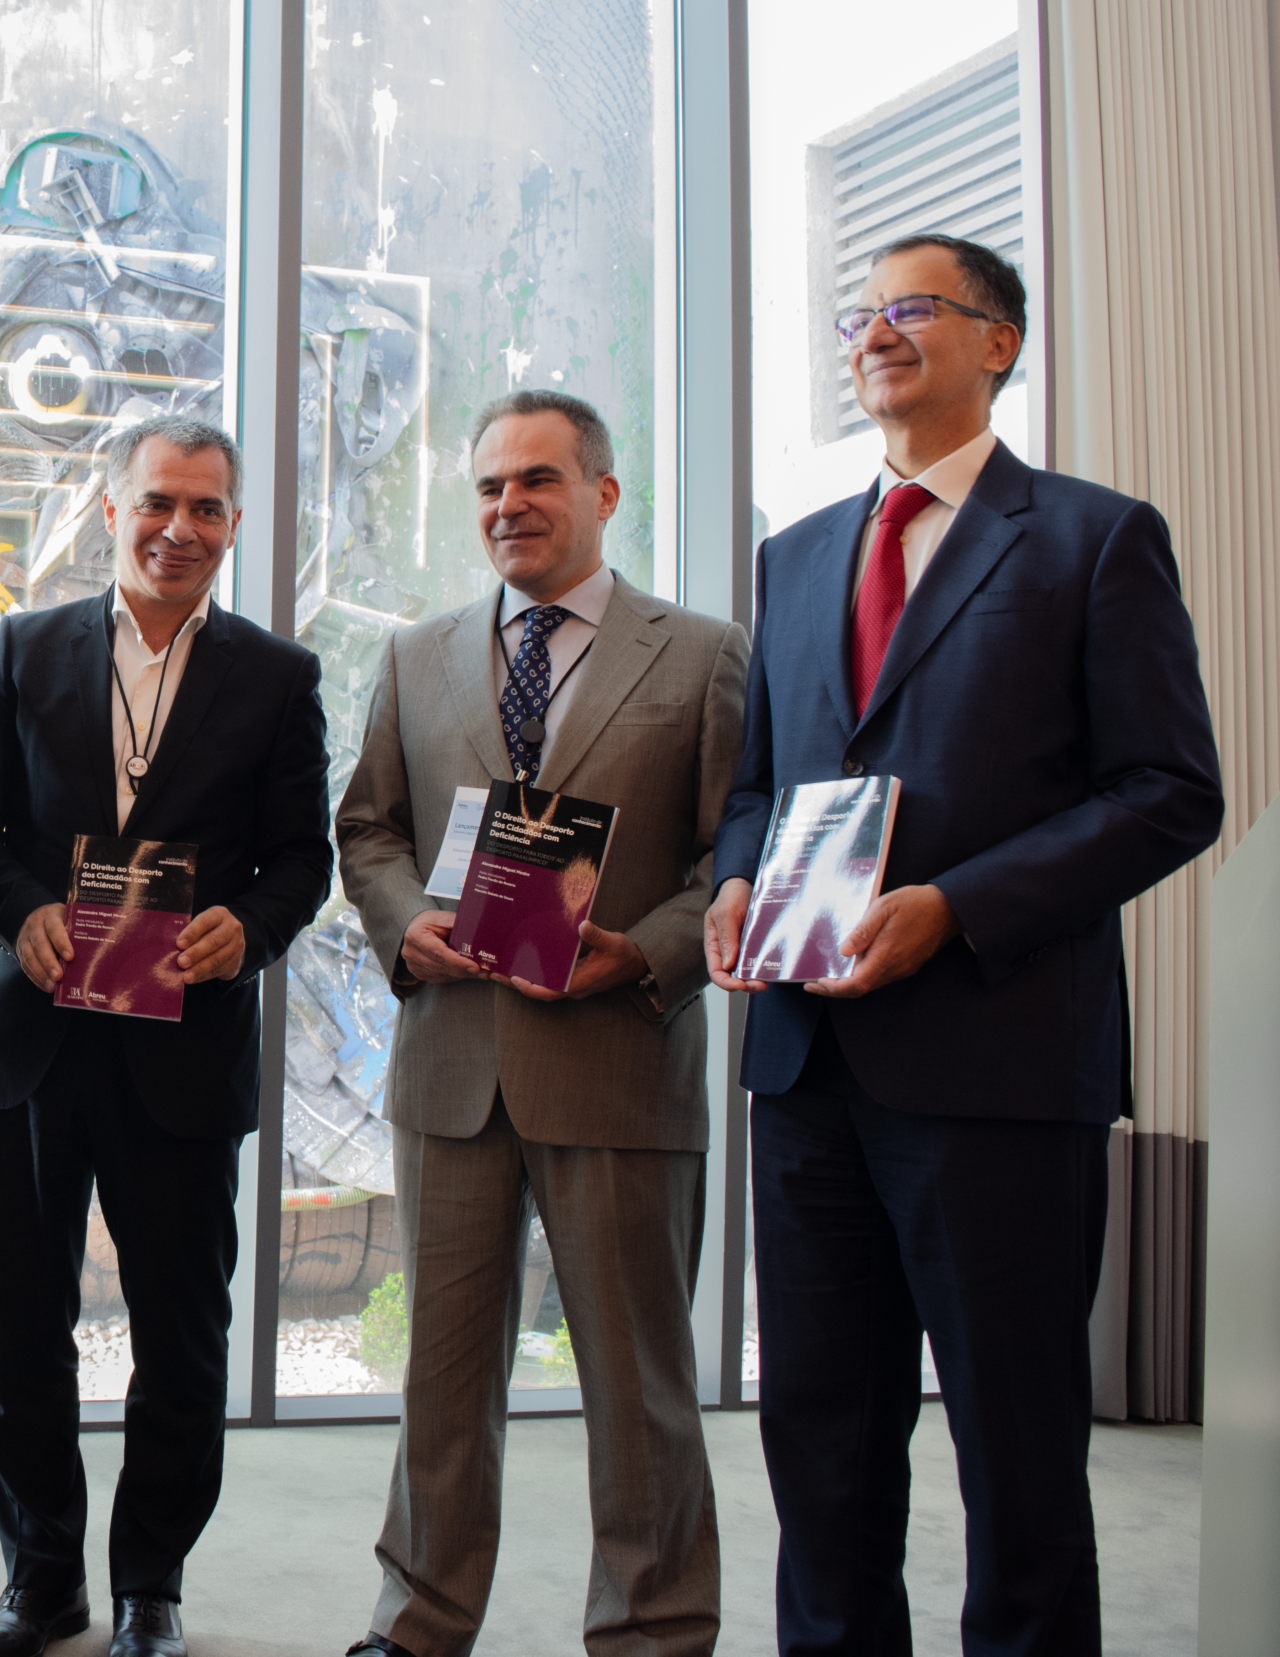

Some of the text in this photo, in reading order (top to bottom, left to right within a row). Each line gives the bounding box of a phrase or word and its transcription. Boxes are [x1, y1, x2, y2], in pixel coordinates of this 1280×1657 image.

[502, 812, 528, 824] Direito
[540, 822, 575, 836] Desporto
[490, 829, 531, 845] Deficiência
[492, 820, 560, 842] dos Cidadãos com
[90, 863, 115, 871] Direito
[129, 867, 163, 876] Desporto
[96, 873, 132, 882] Cidadãos
[81, 880, 122, 890] Deficiência
[479, 950, 496, 960] Abreu
